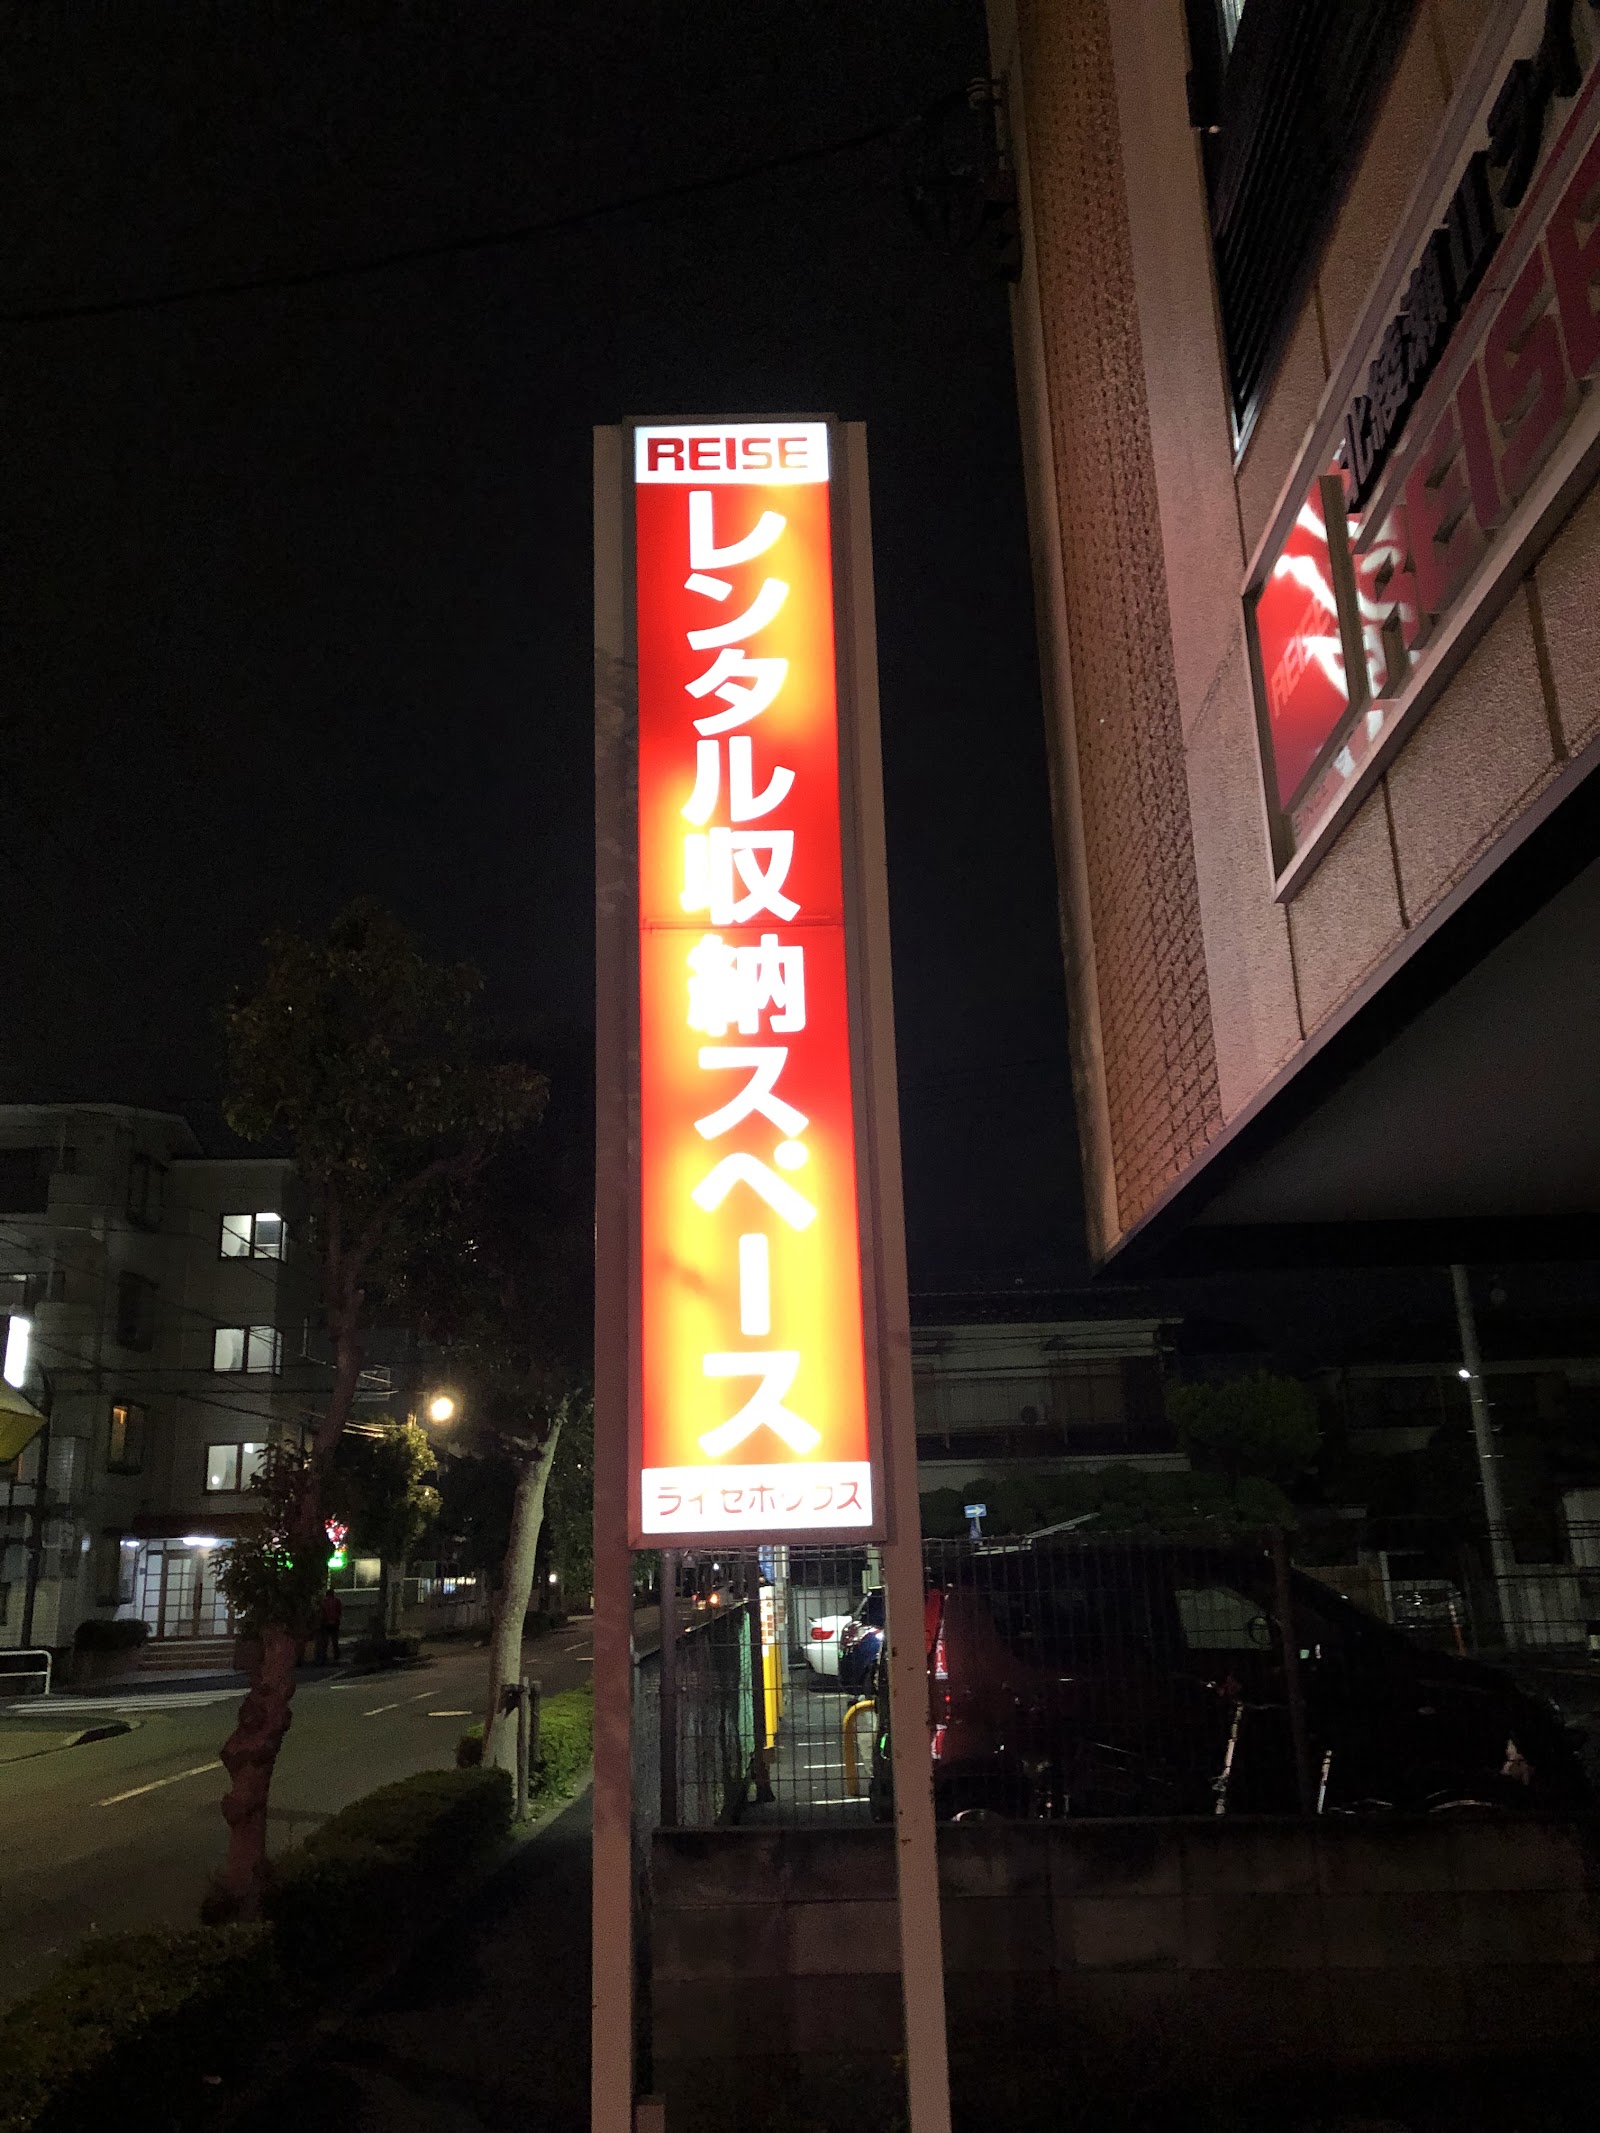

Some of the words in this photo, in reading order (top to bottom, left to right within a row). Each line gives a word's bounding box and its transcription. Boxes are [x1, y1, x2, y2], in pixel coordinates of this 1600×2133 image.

[647, 436, 809, 472] REISE
[679, 489, 821, 1458] レンタル収納スペース
